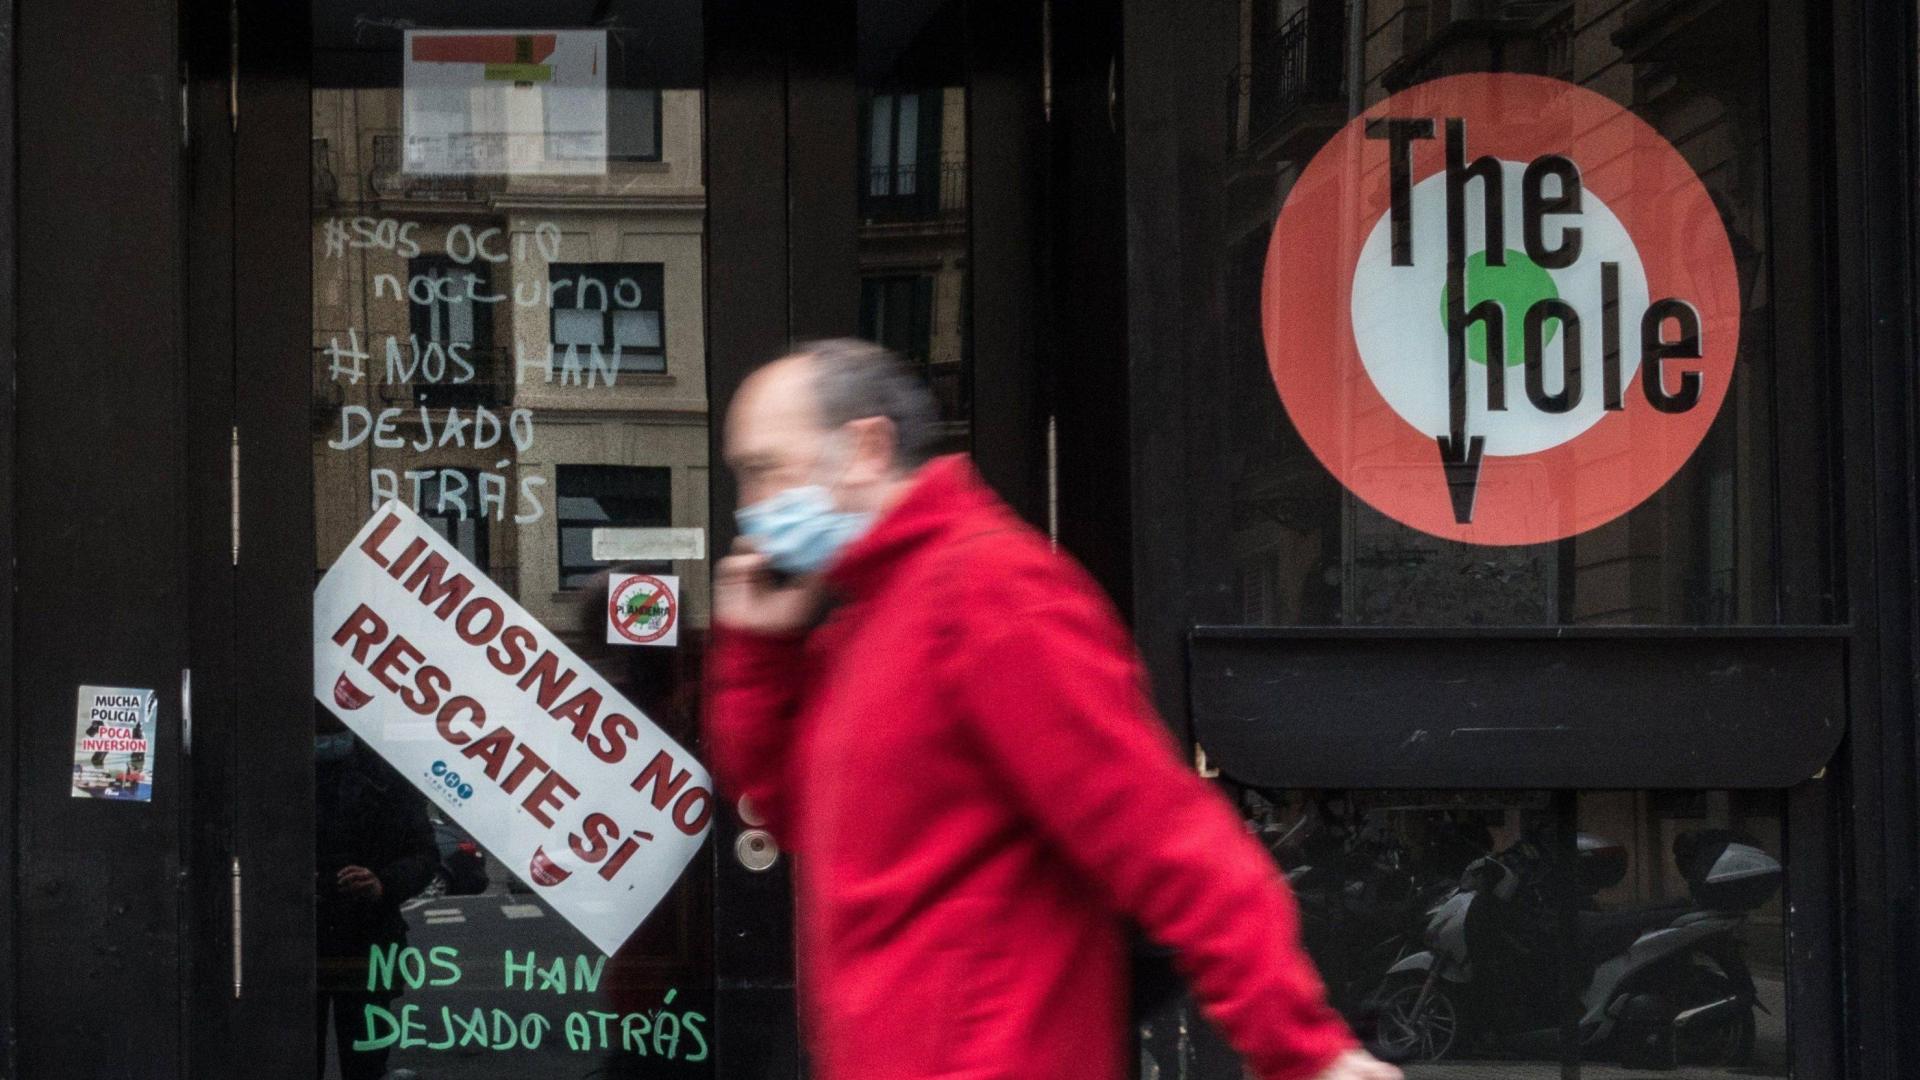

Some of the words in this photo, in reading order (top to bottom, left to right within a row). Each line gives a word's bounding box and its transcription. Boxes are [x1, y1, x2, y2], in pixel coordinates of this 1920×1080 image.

[1365, 117, 1584, 269] The
[374, 273, 643, 312] nocturno
[514, 342, 621, 389] HAN
[1446, 261, 1704, 414] hole
[328, 394, 534, 452] DEJADO
[371, 460, 546, 524] ATRÁS
[95, 695, 140, 707] MUCHA
[360, 512, 639, 764] LIMOSNAS
[631, 749, 713, 836] NO
[91, 707, 137, 722] POLICÍA
[99, 727, 131, 739] POCA
[331, 603, 581, 829] RESCATE
[568, 812, 654, 881] SÍ
[367, 943, 462, 991] NOS
[504, 950, 607, 994] HAN
[353, 1004, 551, 1051] DEJADO
[564, 988, 708, 1061] ATRÁS
